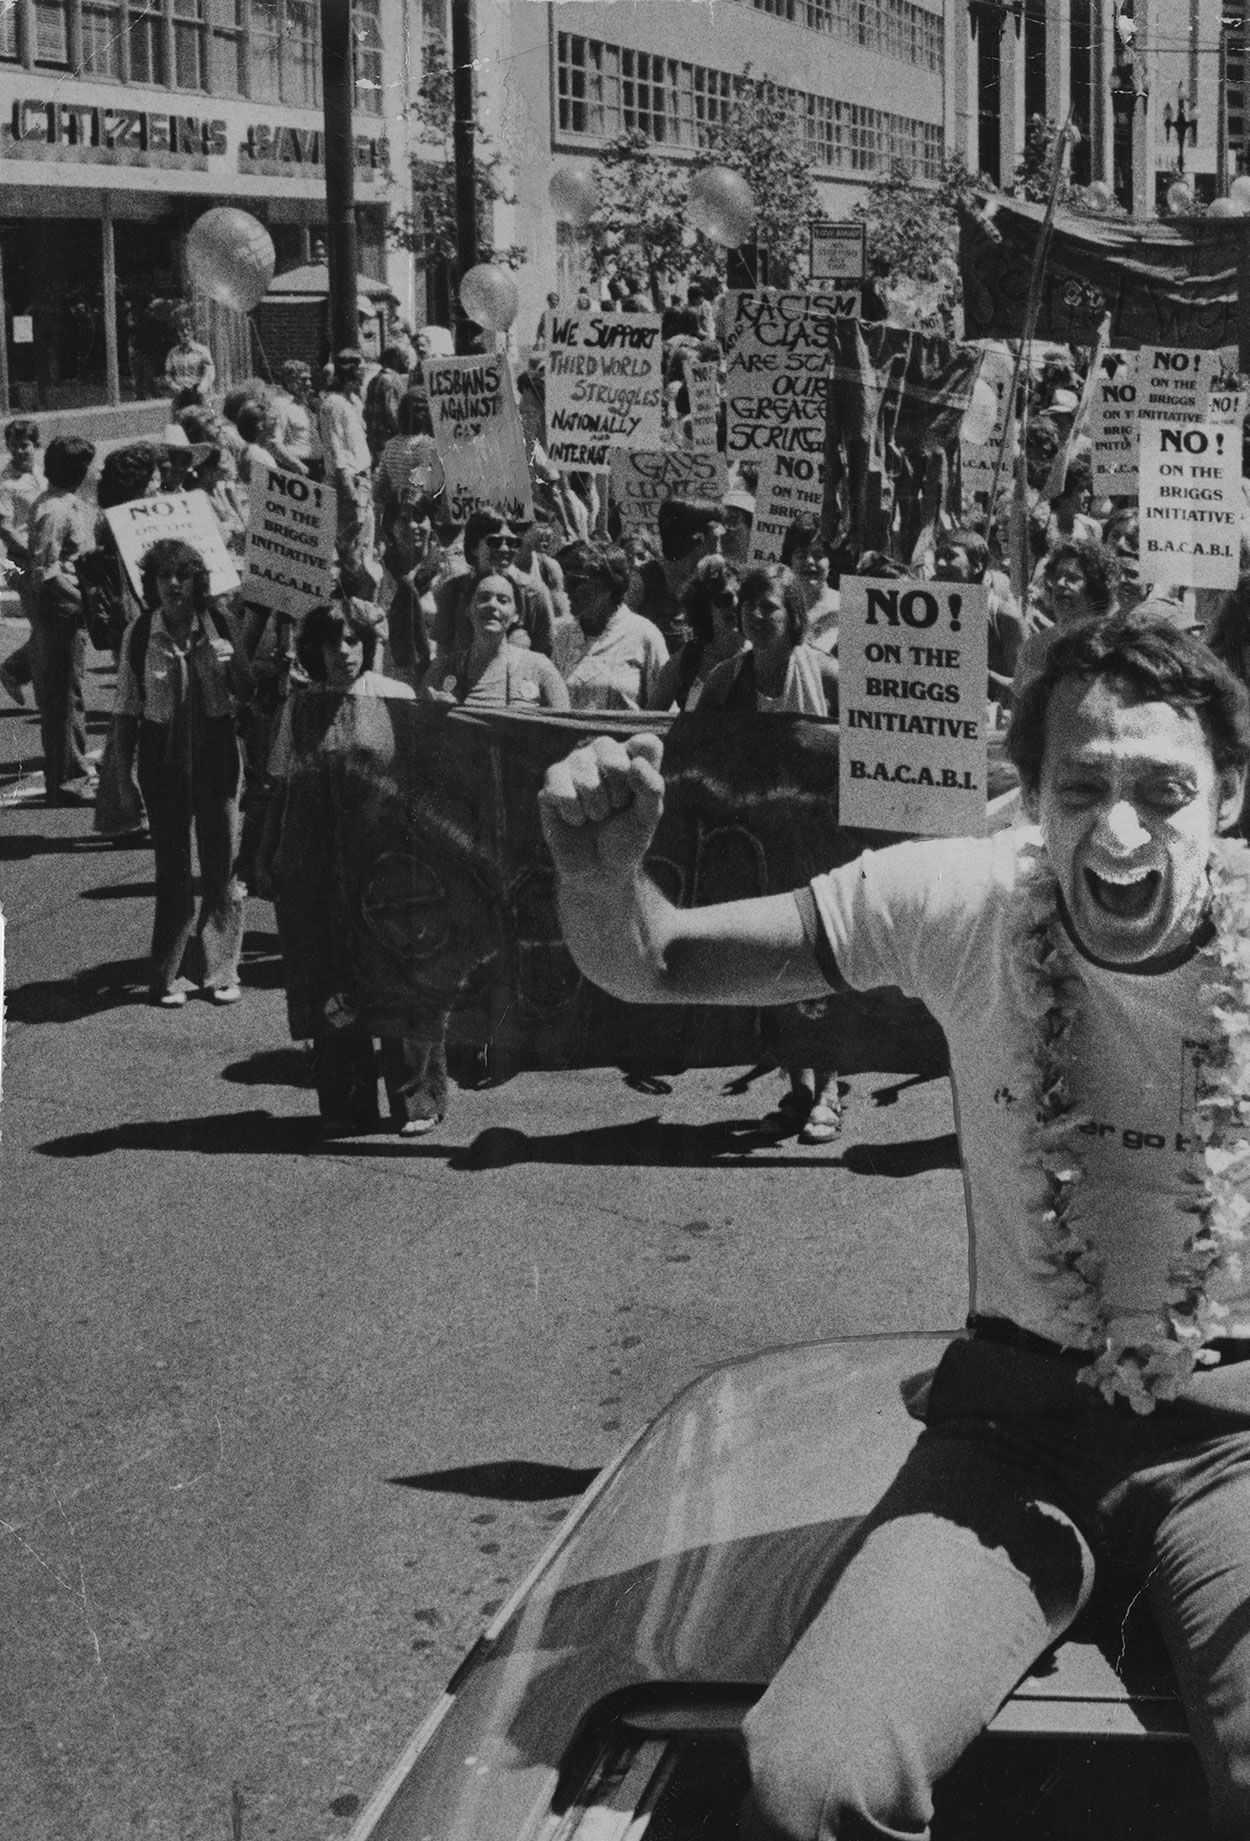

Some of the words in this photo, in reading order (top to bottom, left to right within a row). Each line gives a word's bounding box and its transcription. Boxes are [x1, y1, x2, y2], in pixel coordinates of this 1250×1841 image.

[11, 98, 227, 156] CITIZENS
[246, 123, 391, 170] SAVIGS
[735, 292, 857, 327] RACISM
[552, 317, 579, 346] WE
[583, 318, 660, 350] SUPPORT
[550, 350, 598, 376] THIRD
[601, 355, 652, 377] WORLD
[728, 352, 779, 373] ARE
[1154, 352, 1201, 373] NO!
[429, 366, 501, 398] LESBIANS
[772, 374, 828, 398] OUR
[1151, 377, 1169, 388] ON
[1174, 380, 1197, 390] THE
[440, 395, 502, 421] AGAINST
[570, 379, 661, 417] STRUGGLES
[1149, 394, 1196, 407] BRIGGS
[551, 409, 642, 437] NATIONALLY
[1103, 411, 1121, 419] ON
[1138, 409, 1205, 424] INITIATIVE
[1160, 429, 1224, 456] NO!
[1160, 464, 1184, 477] ON
[1190, 466, 1224, 479] THE
[267, 471, 322, 508] NO!
[772, 485, 792, 499] ON
[797, 490, 822, 504] THE
[1160, 486, 1224, 501] BRIGGS
[265, 501, 286, 516] ON
[290, 509, 321, 528] THE
[1146, 507, 1236, 525] INITIATIVE
[264, 519, 319, 548] BRIGGS
[251, 533, 328, 570] INITIATIVE
[865, 588, 963, 632] NO!
[865, 643, 901, 664] ON
[909, 647, 960, 669] THE
[865, 677, 961, 703] BRIGGS
[848, 709, 979, 740] INITIATIVE
[850, 760, 978, 790] B.A.C.A.B.I.
